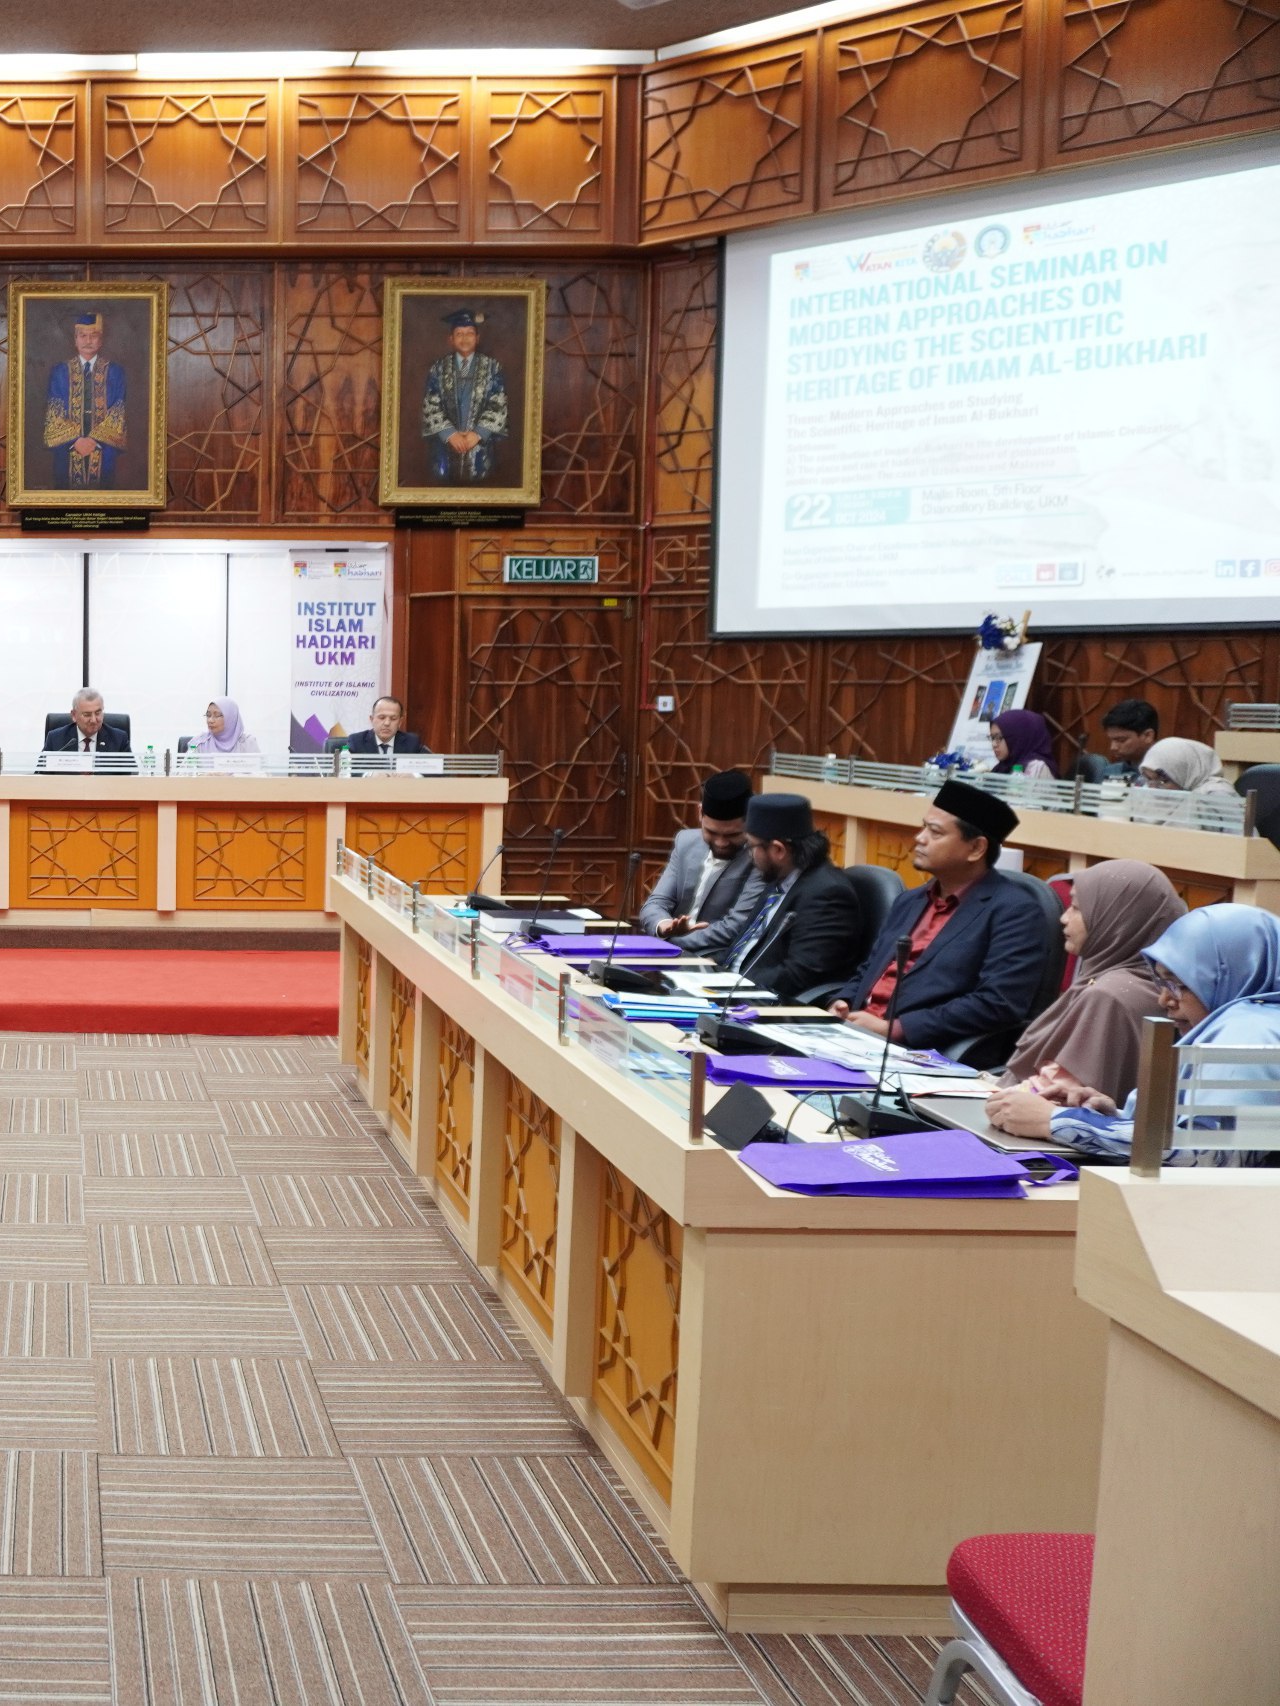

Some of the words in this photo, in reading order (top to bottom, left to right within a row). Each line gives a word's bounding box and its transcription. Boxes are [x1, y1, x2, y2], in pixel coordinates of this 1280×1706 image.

[790, 270, 982, 318] INTERNATIONAL
[990, 247, 1117, 289] SEMINAR
[1126, 239, 1168, 269] ON
[788, 312, 890, 347] MODERN
[897, 286, 1073, 332] APPROACHES
[1082, 278, 1122, 307] ON
[787, 339, 907, 375] STUDYING
[914, 332, 964, 359] THE
[970, 311, 1124, 352] SCIENTIFIC
[786, 369, 902, 403] HERITAGE
[908, 364, 939, 390] OF
[947, 355, 1020, 385] IMAM
[1028, 331, 1208, 376] AL-BUKHARI
[829, 408, 873, 421] Modern
[876, 400, 945, 418] Approaches
[948, 399, 963, 410] on
[966, 391, 1024, 409] Studying
[1015, 481, 1043, 495] Floor
[1038, 494, 1068, 508] UKM
[791, 493, 832, 528] 22
[511, 560, 577, 580] KELUAR
[297, 601, 377, 616] INSTITUT
[308, 618, 364, 633] ISLAM
[296, 635, 376, 650] HADHARI
[315, 651, 355, 666] UKM
[345, 681, 376, 689] ISLAMIC
